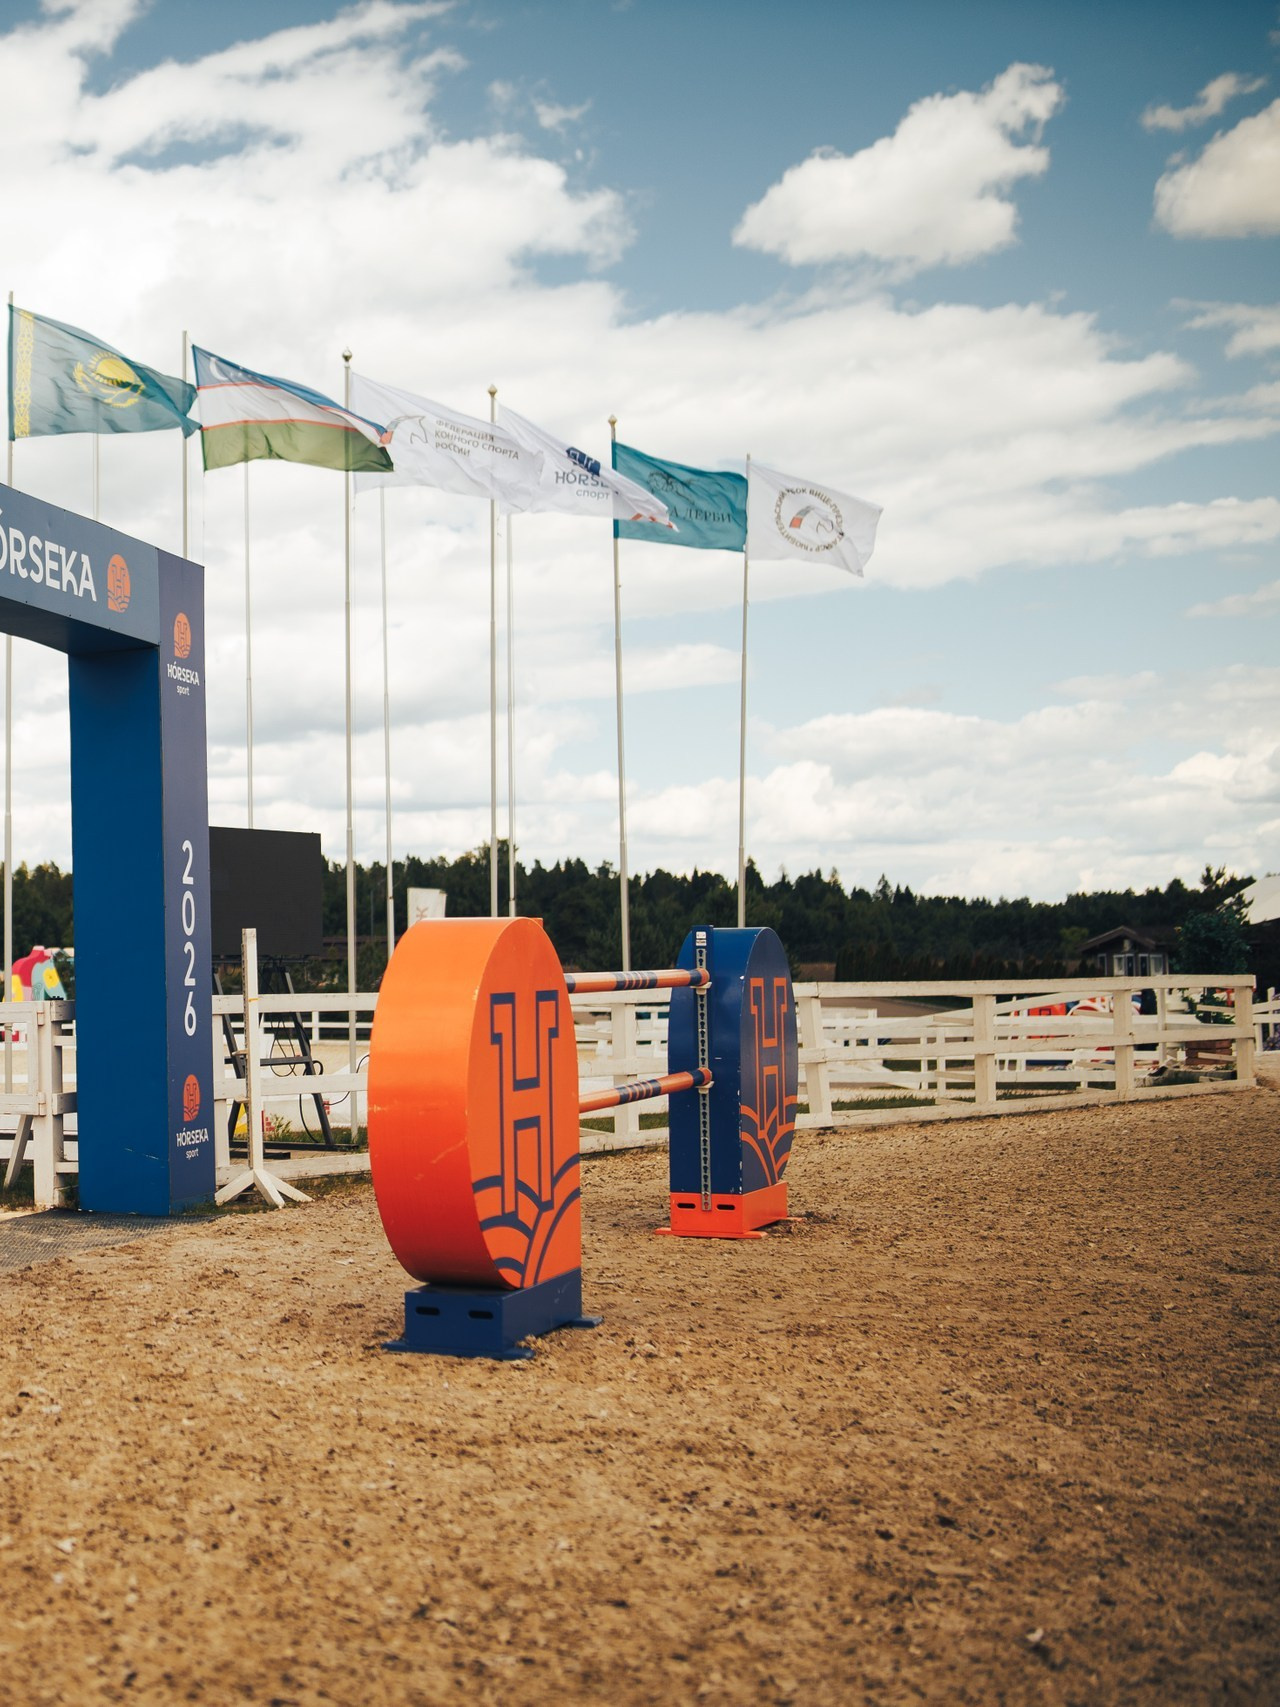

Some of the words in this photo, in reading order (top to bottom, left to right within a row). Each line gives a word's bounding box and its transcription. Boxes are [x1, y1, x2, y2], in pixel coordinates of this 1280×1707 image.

[436, 419, 495, 442] ФЕДЕРАЦИЯ
[435, 430, 479, 448] КОННОГО
[482, 443, 519, 460] СПОРТА
[435, 441, 470, 457] РОССИИ
[576, 488, 610, 500] спорт
[167, 661, 200, 686] HÓRSEKA
[176, 685, 190, 696] sport
[182, 839, 197, 1037] 2026
[176, 1127, 209, 1147] HÓRSEKA
[186, 1148, 199, 1160] sport
